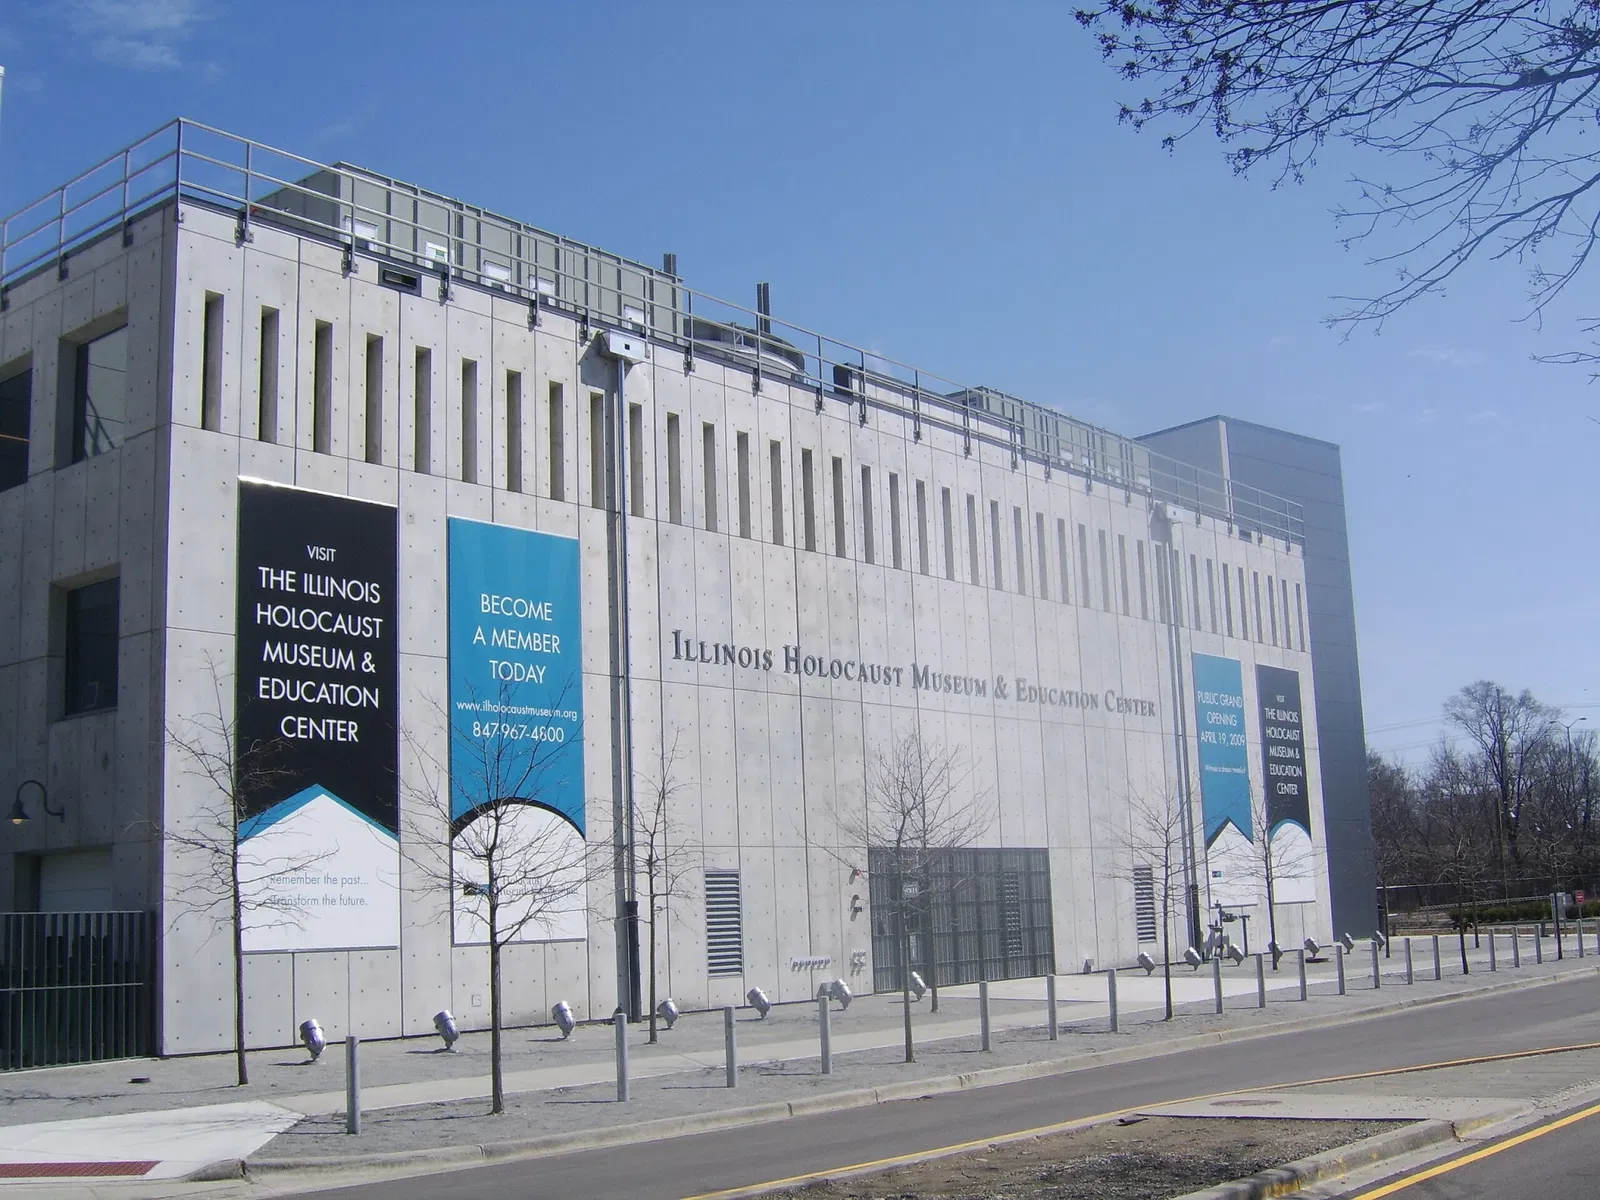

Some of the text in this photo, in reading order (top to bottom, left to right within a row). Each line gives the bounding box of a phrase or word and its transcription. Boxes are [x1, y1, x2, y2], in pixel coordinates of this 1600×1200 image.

[307, 545, 336, 563] VISIT
[258, 566, 381, 604] THE ILLINOIS
[480, 594, 553, 622] BECOME
[256, 603, 383, 639] HOLOCAUST
[472, 626, 561, 654] A MEMBER
[262, 640, 376, 674] MUSEUM &
[489, 660, 546, 684] TODAY
[259, 677, 379, 709] EDUCATION
[994, 674, 1009, 700] &
[1197, 691, 1243, 708] PUBLIC GRAND
[456, 699, 577, 721] www.ilholocaustmuseum.org
[1206, 711, 1238, 727] OPENING
[1265, 707, 1299, 723] THE ILLINOIS
[280, 715, 359, 743] CENTER
[473, 721, 564, 743] 847-967-4800
[1200, 730, 1246, 747] APRIL 19, 2009
[1266, 726, 1301, 741] HOLOCAUST
[1269, 745, 1295, 759] MUSEUM
[1269, 763, 1303, 777] EDUCATION
[1276, 782, 1299, 795] CENTER
[270, 872, 369, 888] Remember the past...
[271, 894, 368, 906] Transform the future.
